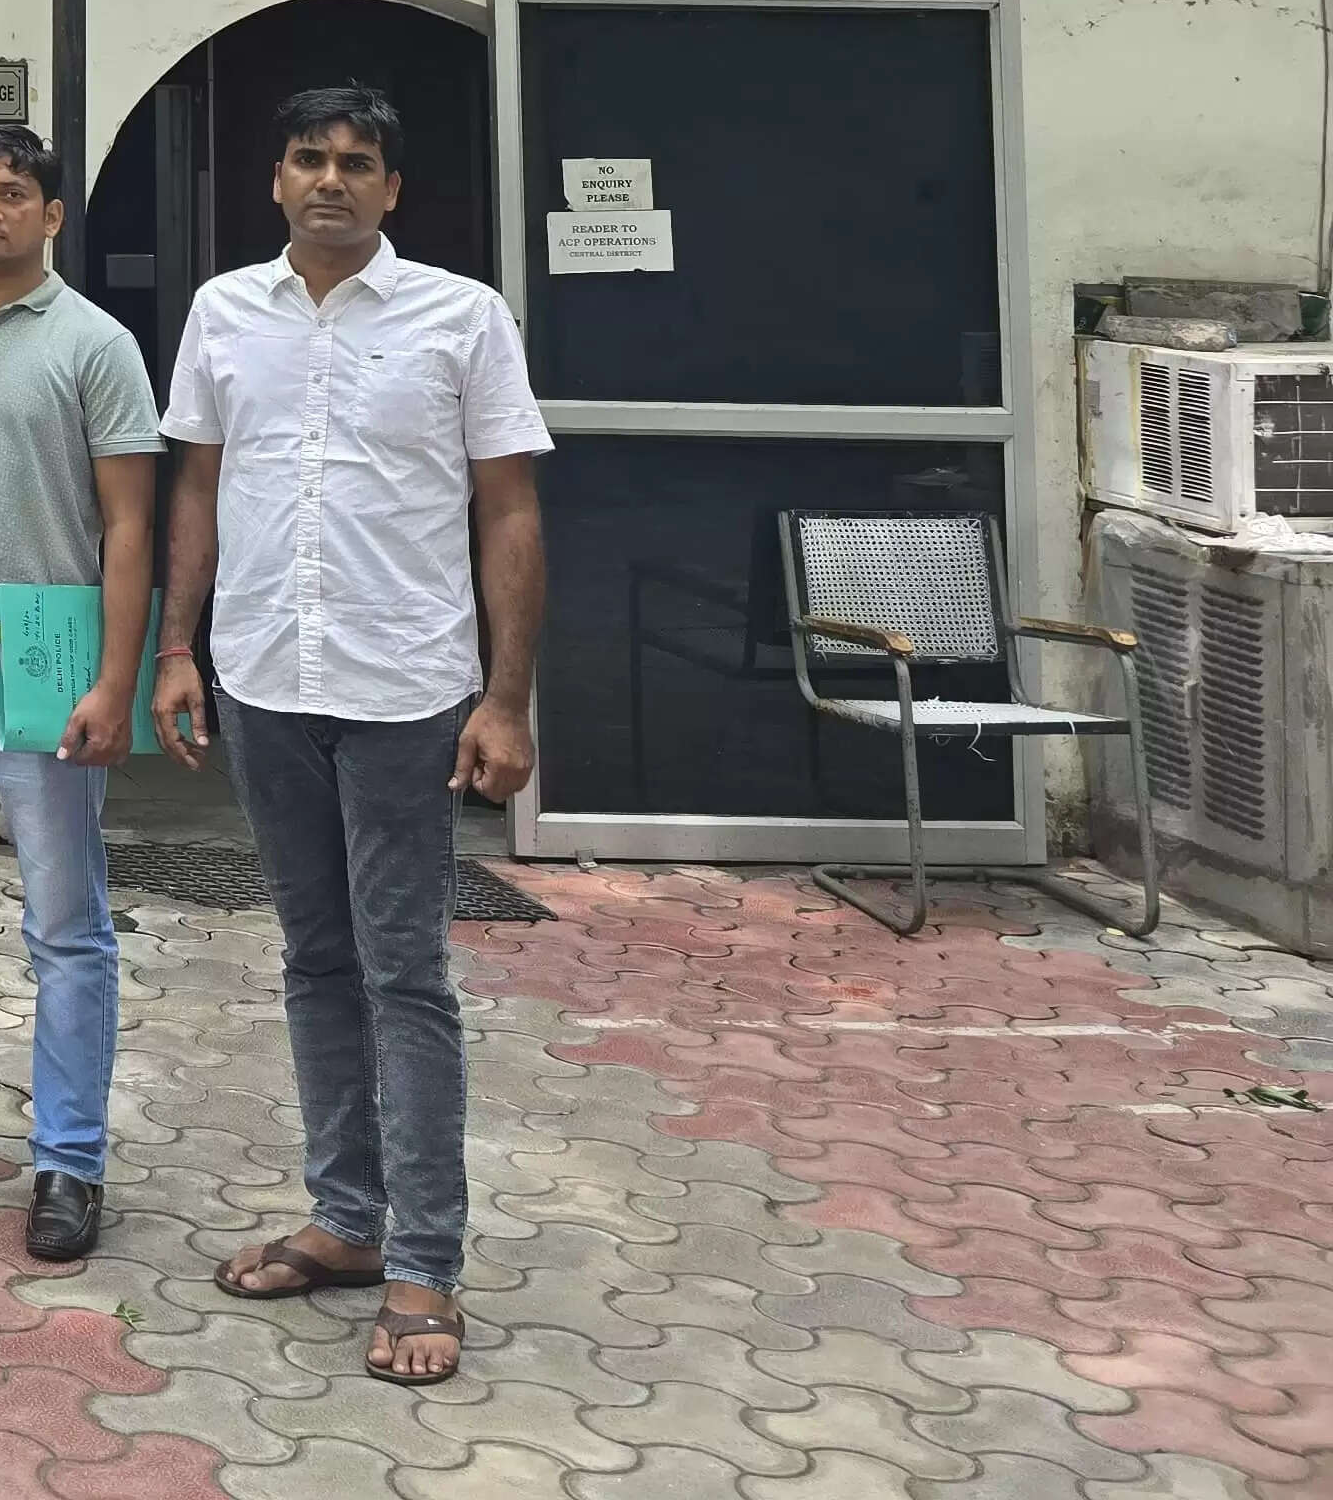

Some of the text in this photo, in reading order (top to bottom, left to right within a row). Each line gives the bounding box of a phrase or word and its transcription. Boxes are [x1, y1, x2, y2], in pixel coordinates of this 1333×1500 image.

[598, 166, 615, 175] NO
[581, 179, 633, 190] ENQUIRY
[586, 194, 630, 203] PLEASE
[572, 224, 637, 234] READER TO
[558, 237, 657, 247] ACP OPERATIONS
[54, 632, 62, 665] POLICE
